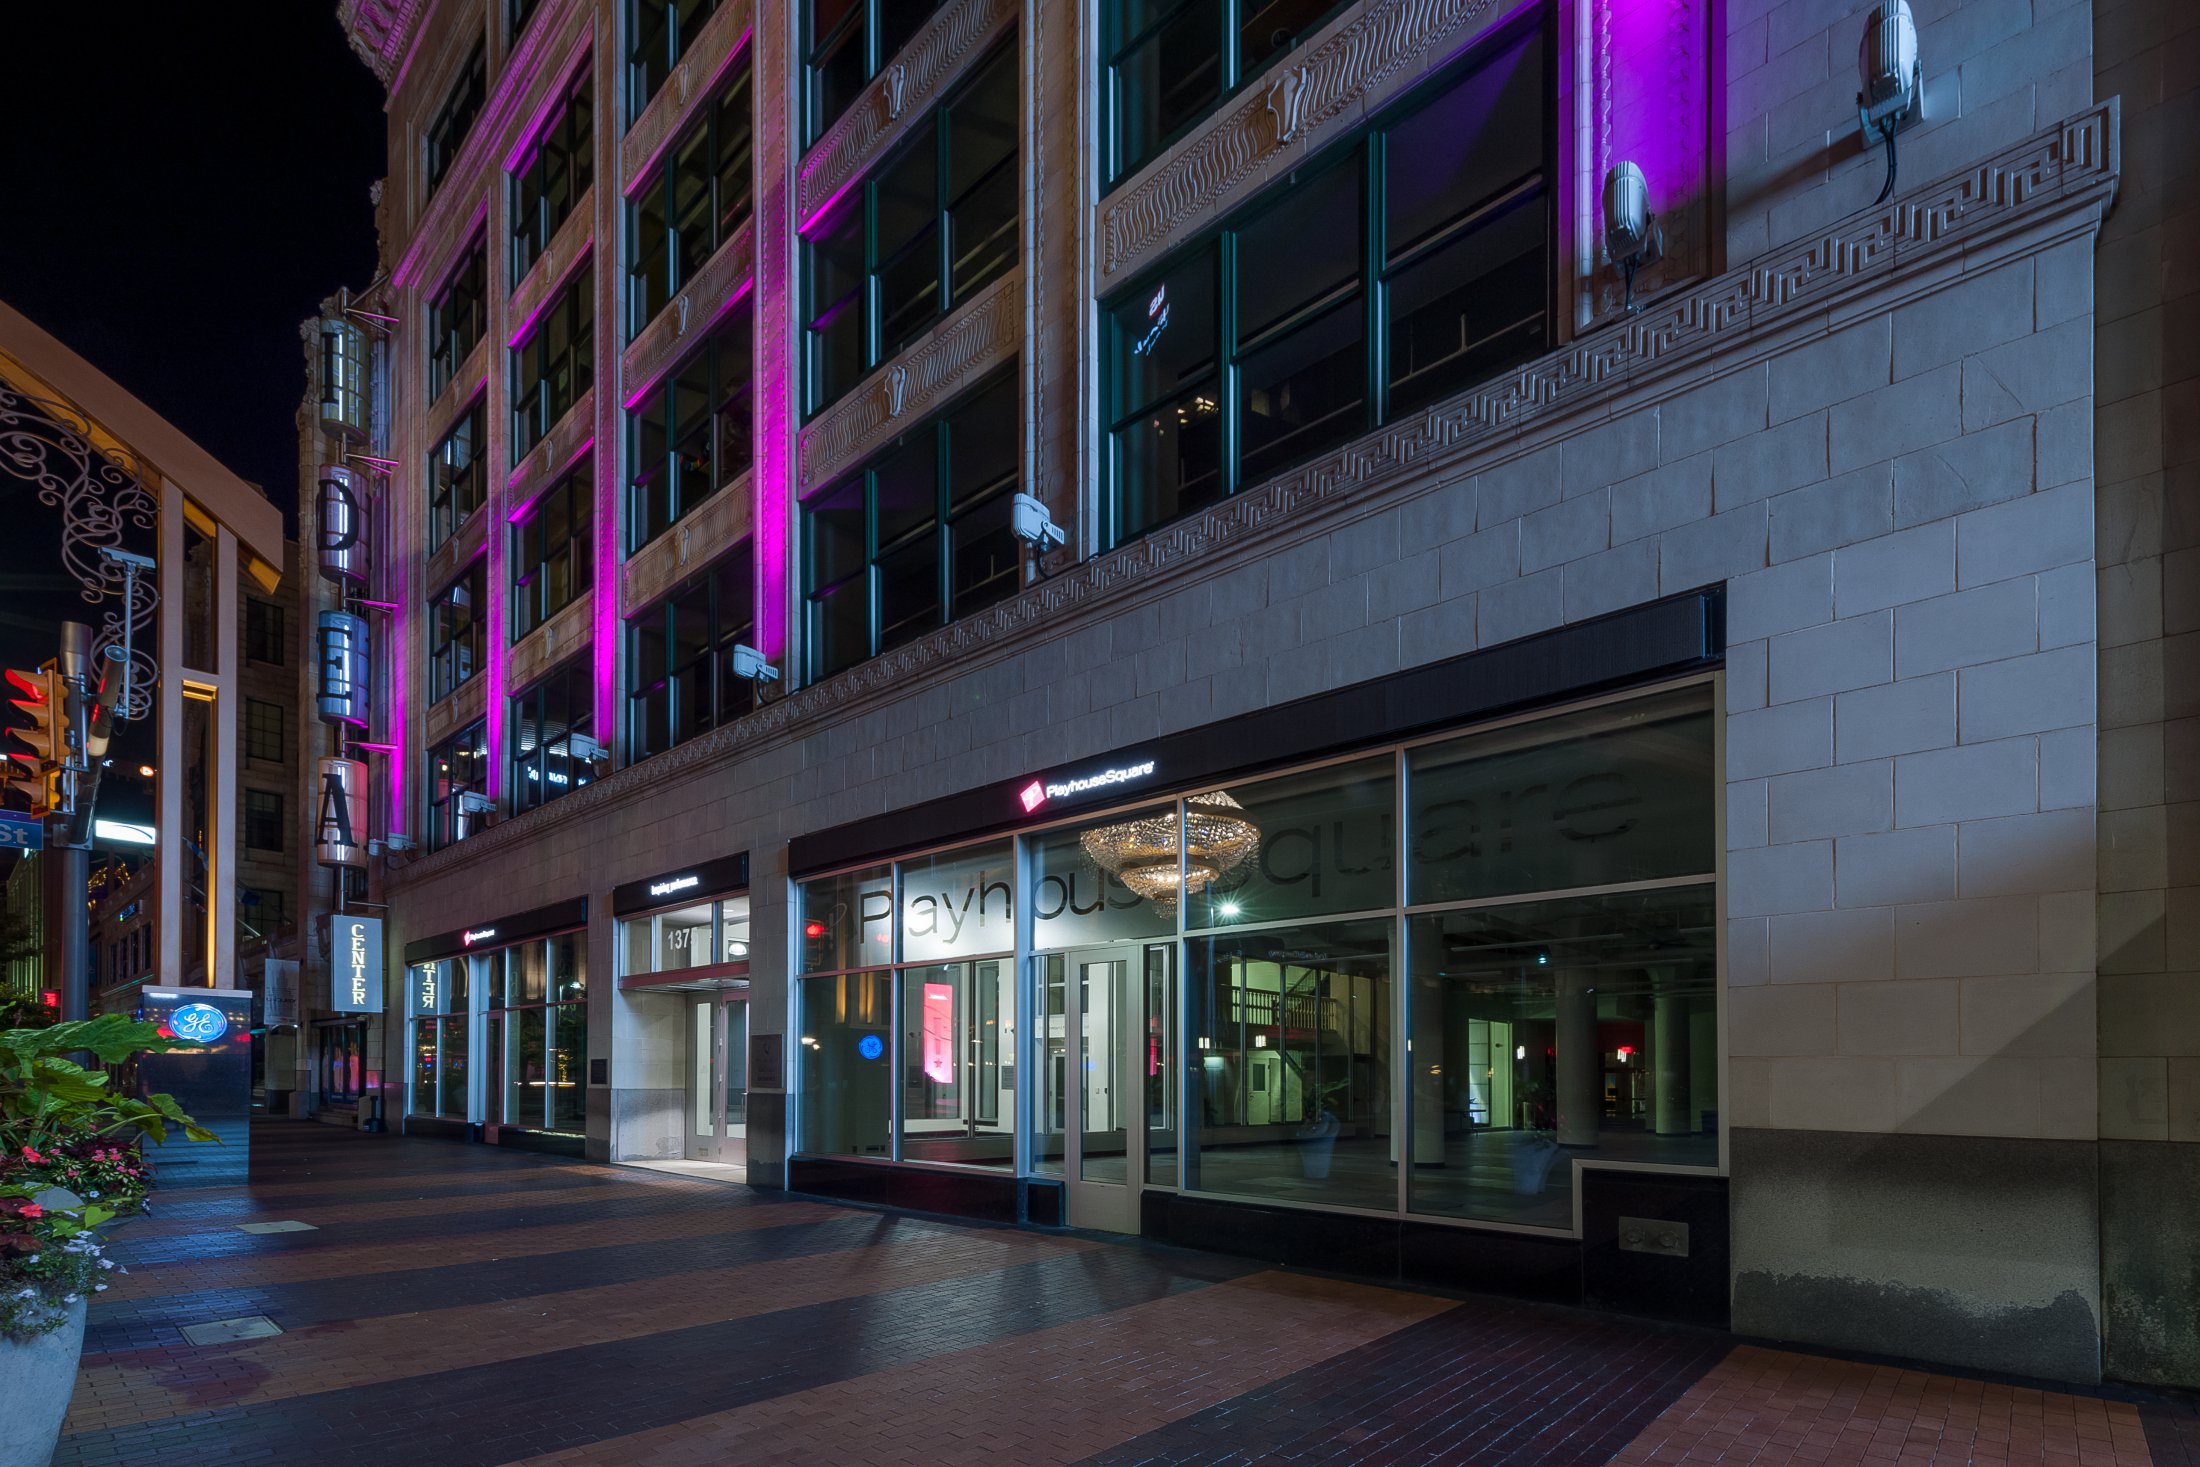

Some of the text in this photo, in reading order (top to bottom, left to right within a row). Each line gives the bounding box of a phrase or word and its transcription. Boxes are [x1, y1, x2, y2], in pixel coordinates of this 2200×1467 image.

[316, 332, 360, 848] IDEA
[351, 923, 366, 1005] CENTER
[183, 1012, 214, 1034] GE
